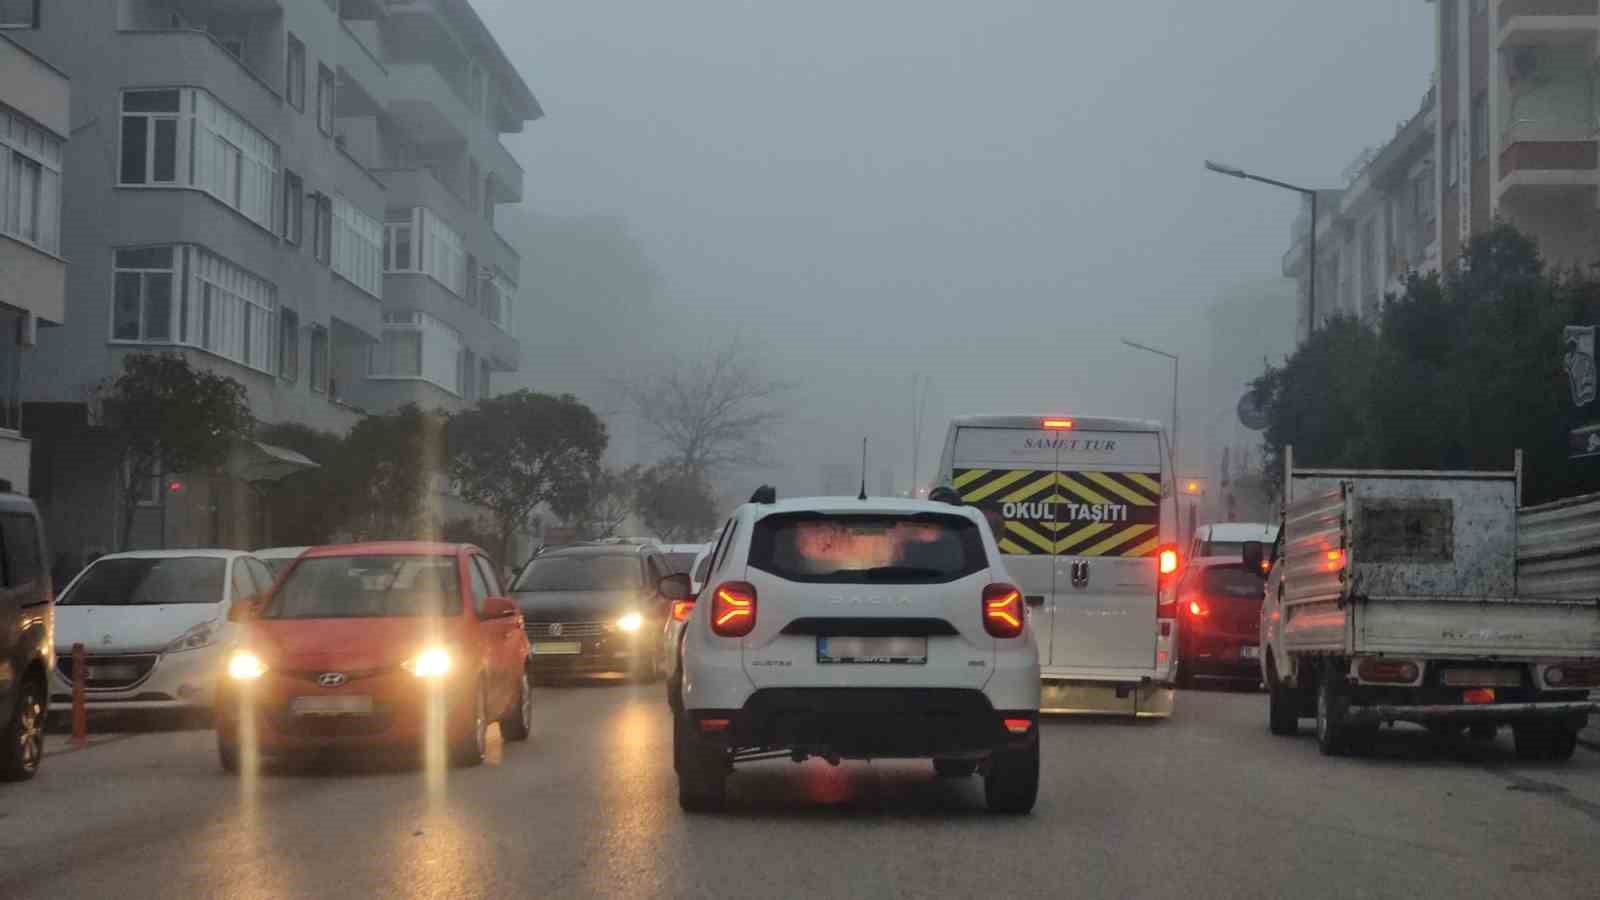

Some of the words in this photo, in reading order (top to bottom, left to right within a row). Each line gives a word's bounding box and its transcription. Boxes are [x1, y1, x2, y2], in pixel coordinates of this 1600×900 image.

[1024, 438, 1078, 449] SAMET
[1084, 439, 1116, 450] TUR
[1003, 502, 1055, 519] OKUL
[1068, 504, 1128, 522] TAŞITI
